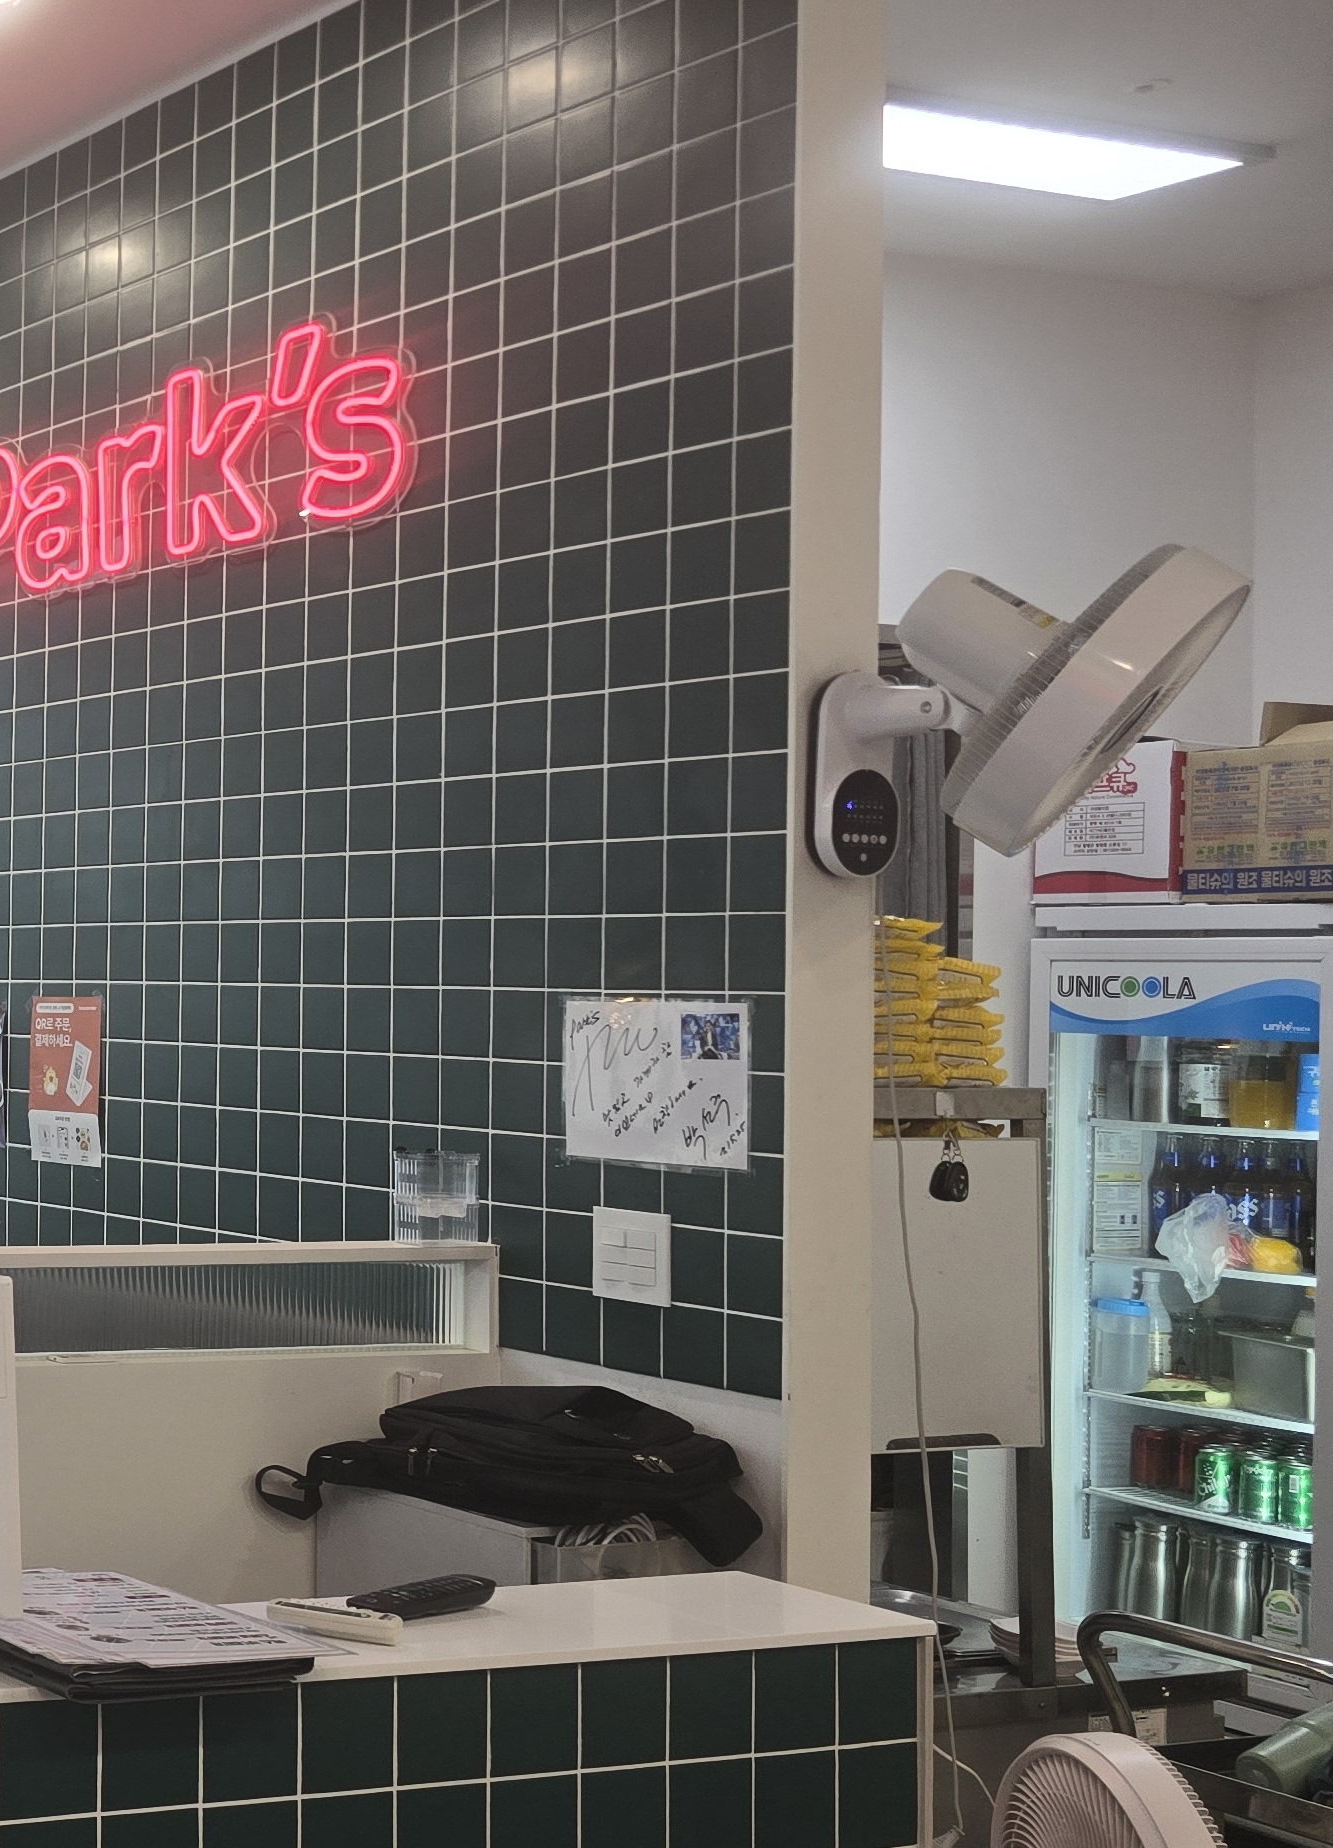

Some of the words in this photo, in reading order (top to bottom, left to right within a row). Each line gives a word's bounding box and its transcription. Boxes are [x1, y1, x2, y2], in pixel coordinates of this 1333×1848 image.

[1187, 872, 1234, 890] 물티슈의
[1236, 871, 1258, 889] 원조
[1261, 869, 1307, 888] 물티슈의
[1309, 868, 1333, 887] 원조
[1057, 975, 1197, 1000] UNICOOLA
